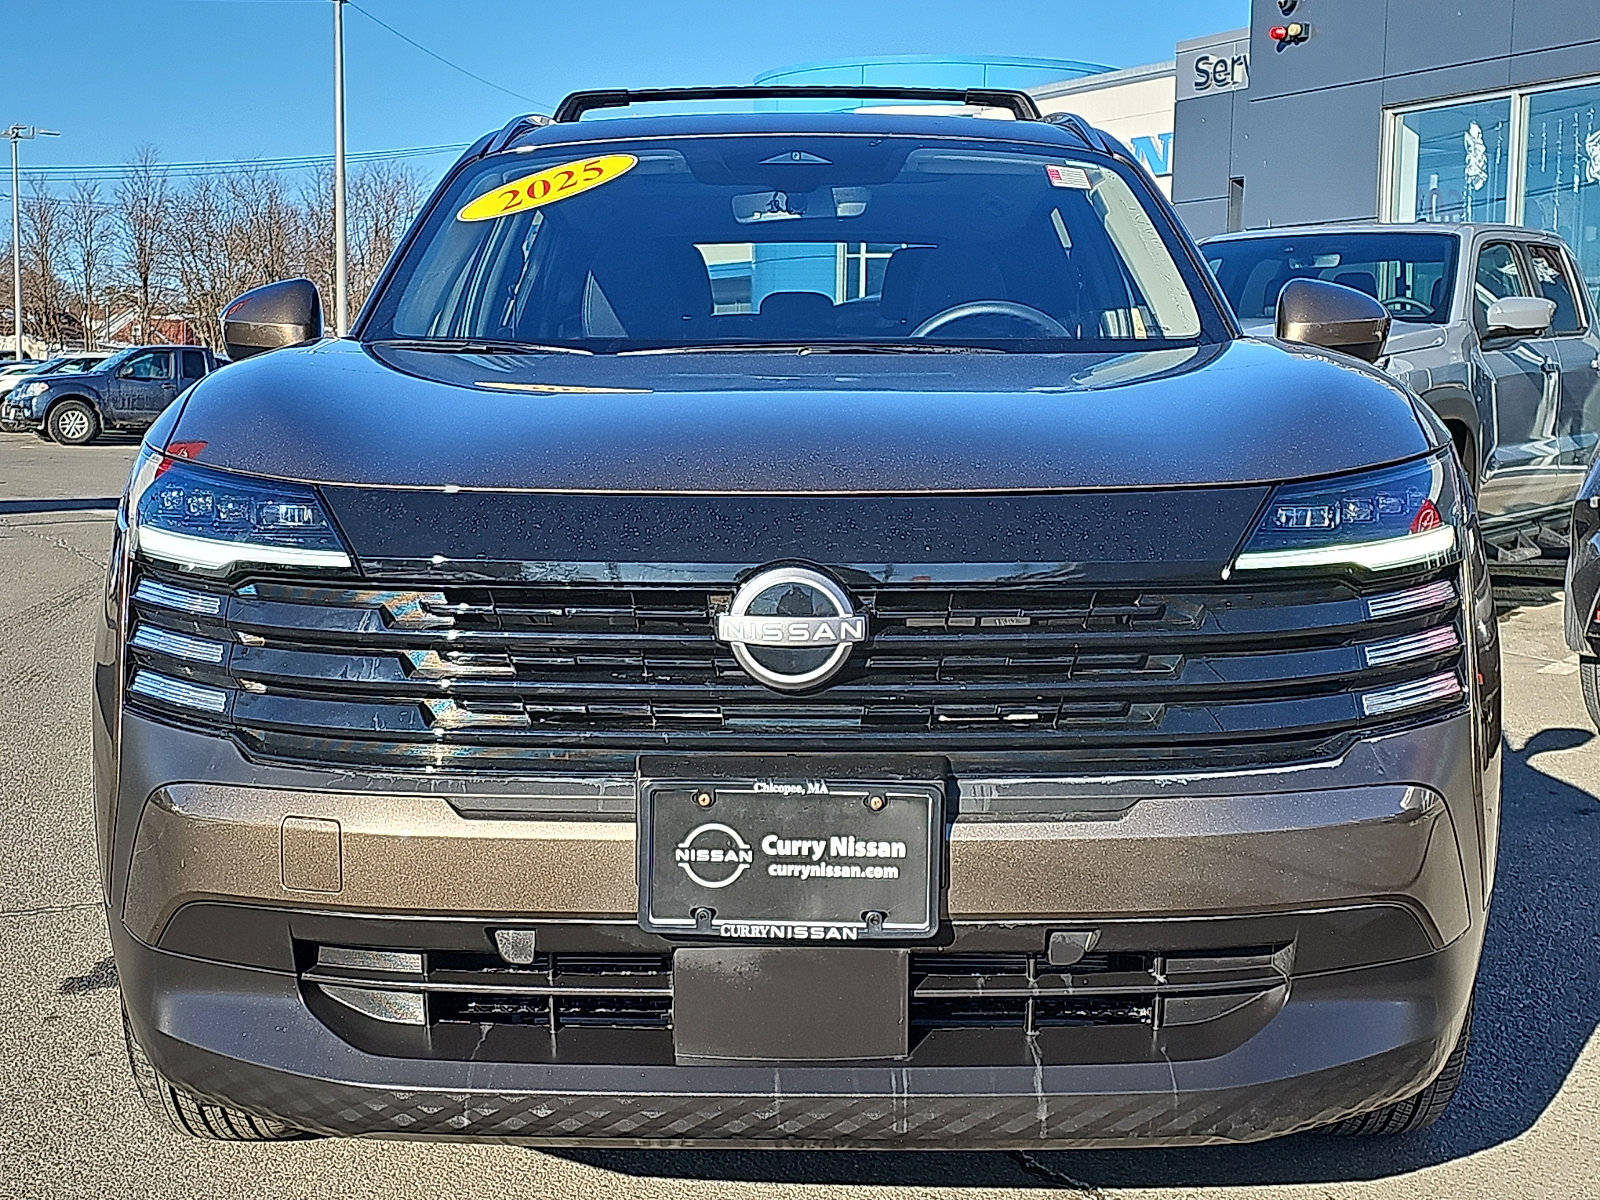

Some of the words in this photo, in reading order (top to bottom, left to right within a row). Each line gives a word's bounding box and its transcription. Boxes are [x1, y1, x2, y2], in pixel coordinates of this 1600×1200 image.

[498, 160, 604, 212] 2025
[723, 620, 862, 641] NISSAN
[806, 783, 829, 794] MA
[675, 849, 753, 863] NISSAN
[761, 835, 826, 861] Curry
[830, 837, 906, 858] Nissan
[768, 862, 899, 880] currynissan.com
